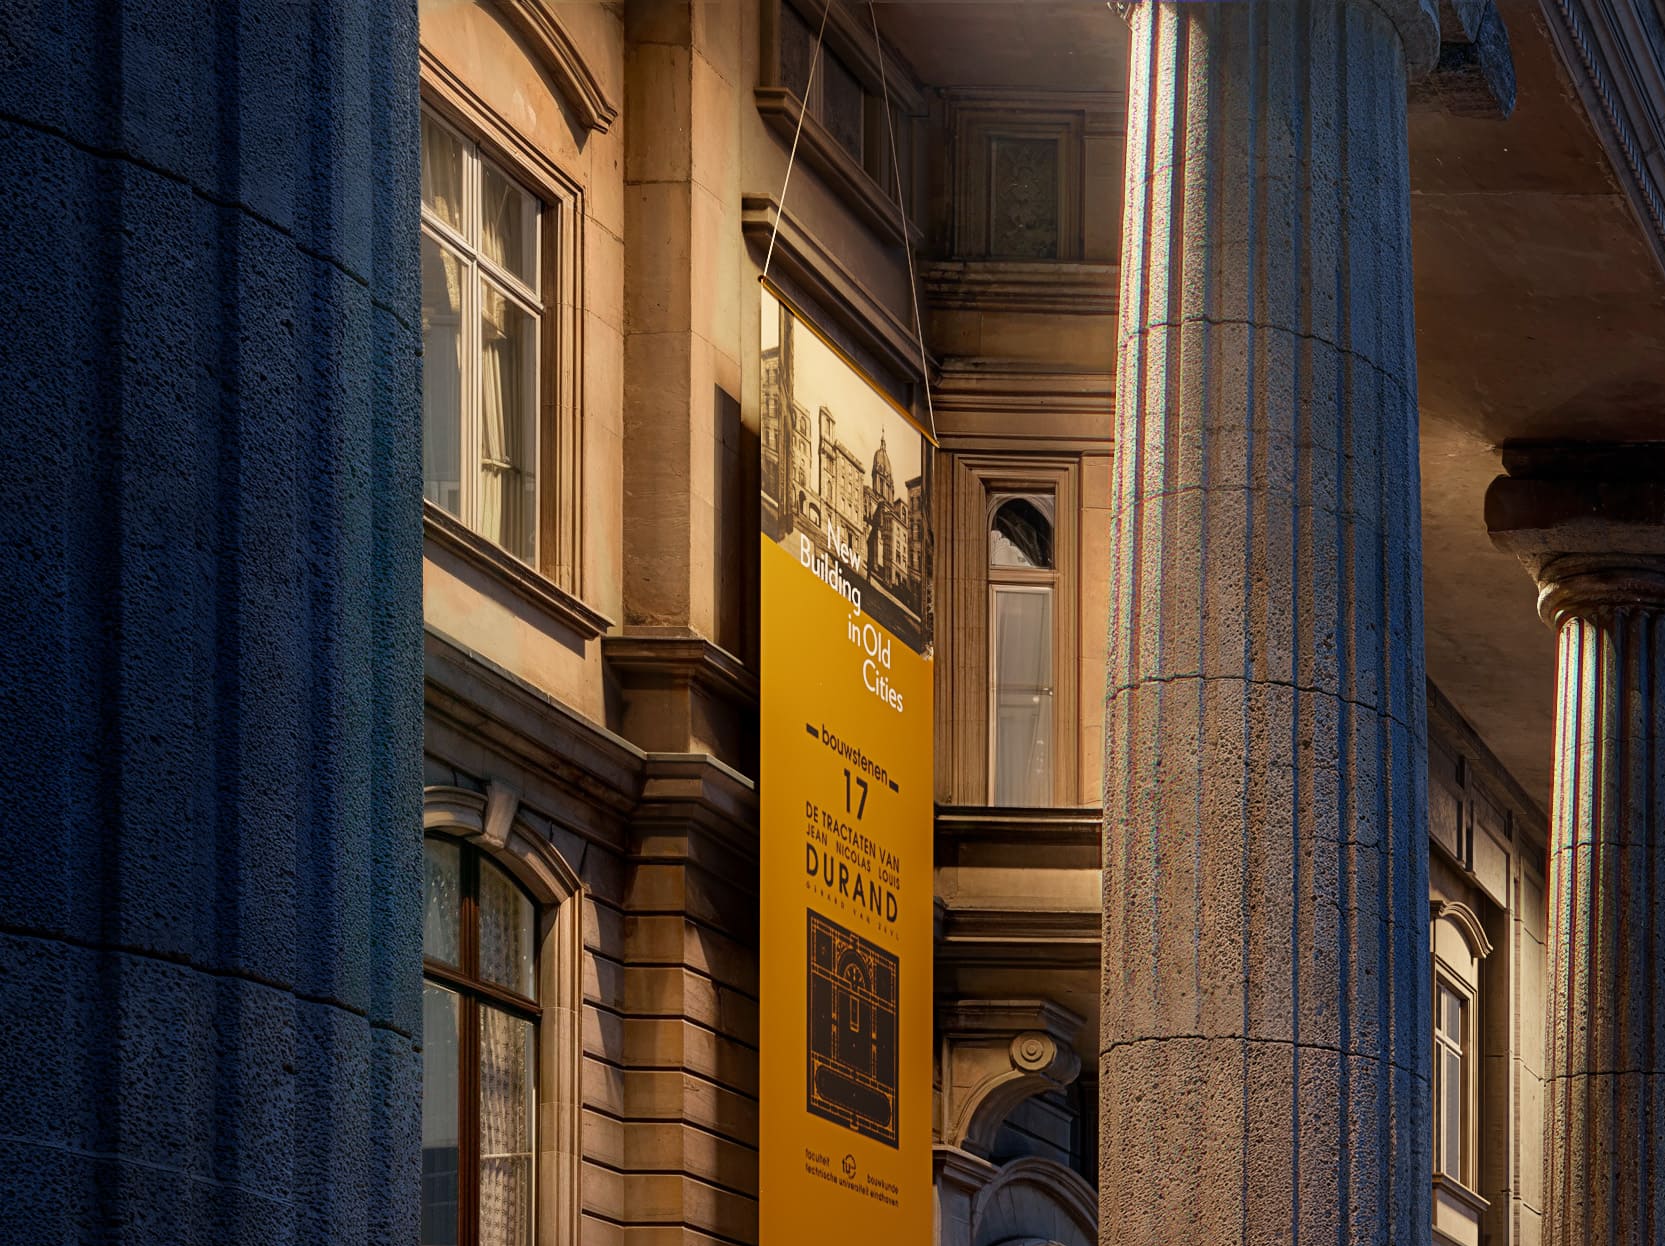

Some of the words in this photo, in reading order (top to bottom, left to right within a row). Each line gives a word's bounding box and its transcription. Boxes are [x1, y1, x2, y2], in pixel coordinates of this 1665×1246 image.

[800, 533, 861, 616] Building
[827, 518, 861, 572] New
[848, 614, 861, 647] in
[863, 624, 891, 669] Old
[863, 659, 903, 713] Cities
[822, 724, 888, 785] bouwstenen
[844, 767, 868, 821] 17
[806, 801, 819, 823] DE
[822, 811, 876, 859] TRACTATEN
[879, 847, 899, 873] VAN
[806, 824, 828, 846] JEAN
[836, 841, 871, 872] NICOLAS
[879, 866, 900, 890] LOUIS
[806, 842, 898, 923] DURAND
